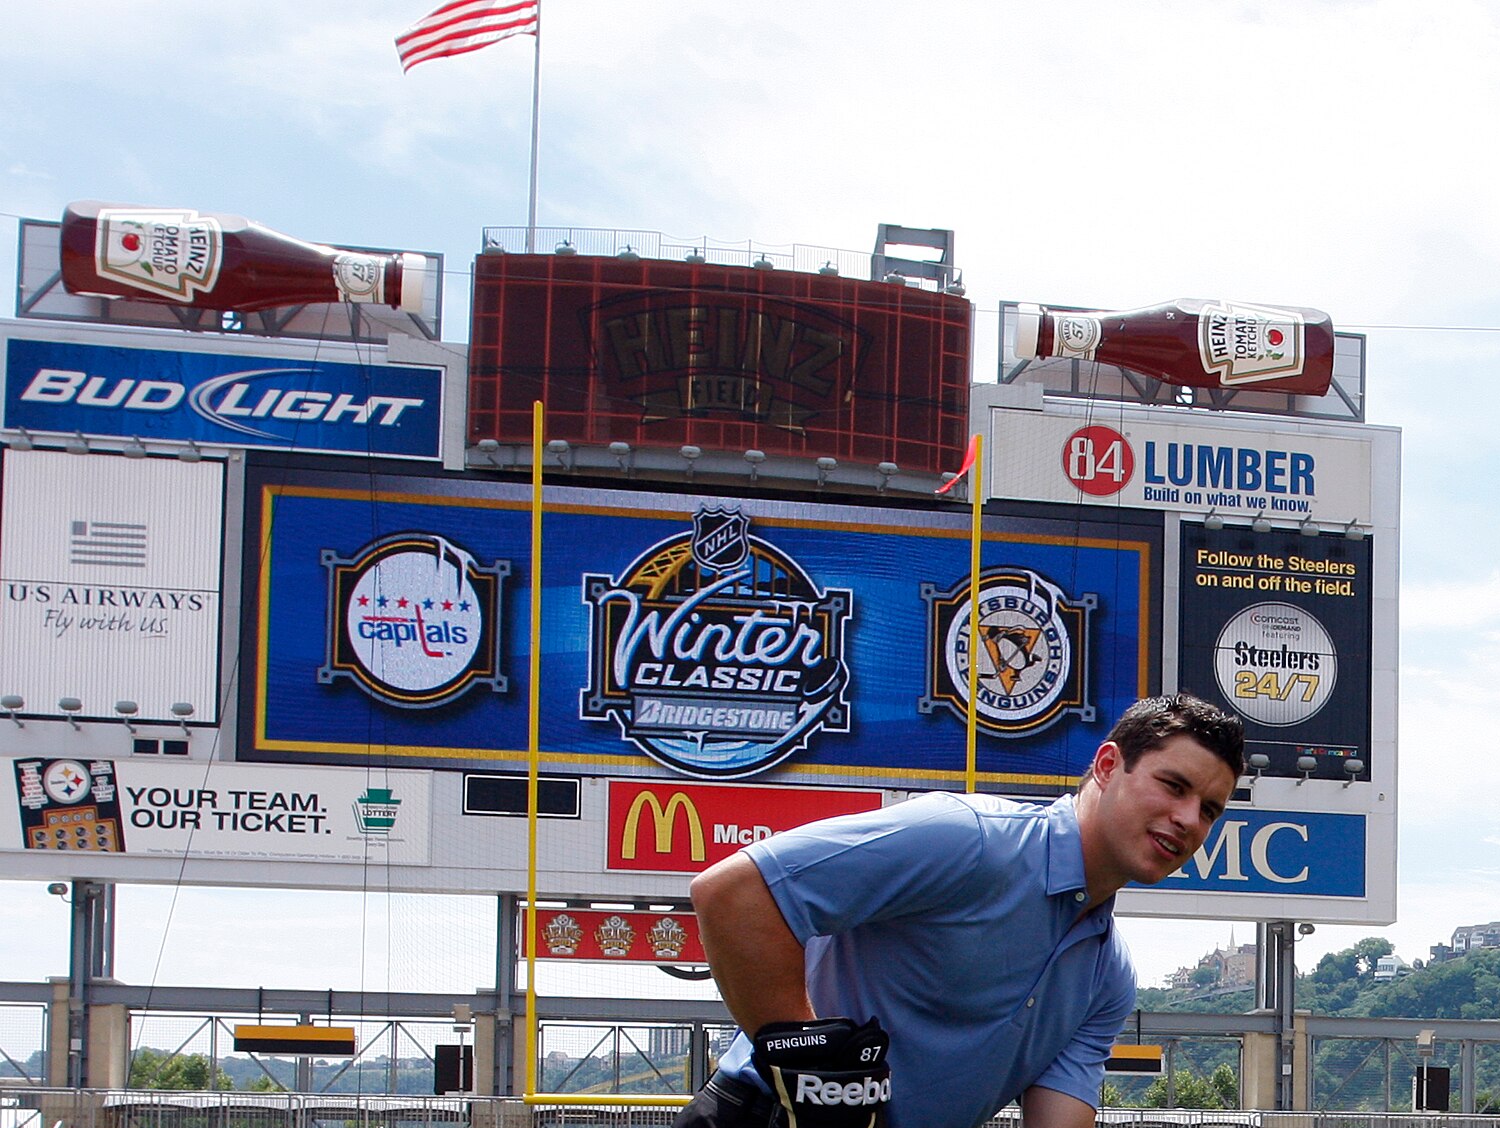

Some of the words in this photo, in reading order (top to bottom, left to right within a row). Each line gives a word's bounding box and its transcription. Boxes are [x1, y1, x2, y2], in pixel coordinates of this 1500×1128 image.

[1072, 321, 1084, 340] 57
[1211, 314, 1229, 358] HEINZ
[1247, 316, 1258, 359] KETCHU
[606, 305, 846, 396] HEINZ
[20, 368, 186, 411] BUD
[215, 383, 425, 427] LIGHT
[1069, 437, 1126, 483] 84
[1144, 440, 1316, 496] LUMBER
[1143, 487, 1180, 503] Build
[1184, 492, 1202, 505] on
[1206, 492, 1242, 509] what
[1245, 498, 1267, 510] we
[1271, 496, 1313, 514] know.
[703, 522, 738, 557] NHL
[1196, 549, 1253, 568] Follow
[1256, 554, 1284, 570] the
[1288, 555, 1356, 575] Steelers
[61, 587, 204, 612] AIRWAYS
[1195, 573, 1218, 587] on
[1221, 575, 1254, 589] and
[1258, 576, 1282, 591] off
[1284, 578, 1312, 594] the
[1314, 579, 1355, 597] field.
[44, 609, 74, 638] Fly
[80, 612, 137, 632] with
[358, 605, 468, 656] capitals
[598, 570, 823, 688] Winter
[1250, 611, 1299, 625] comcast
[1262, 630, 1300, 641] featuring
[1234, 641, 1320, 671] Steelers
[634, 662, 801, 693] CLASSIC
[960, 668, 1058, 709] PNGUINS
[1234, 671, 1320, 702] 24/7
[641, 699, 797, 730] BRIDGESTONE
[126, 786, 218, 811] YOUR
[227, 790, 328, 814] TEAM.
[362, 809, 397, 817] LOTTERY
[131, 808, 201, 831] OUR
[212, 811, 333, 835] TICKET.
[713, 823, 784, 845] McD
[766, 1034, 828, 1051] PENGUINS
[859, 1045, 881, 1062] 87
[795, 1071, 892, 1106] Reebo
